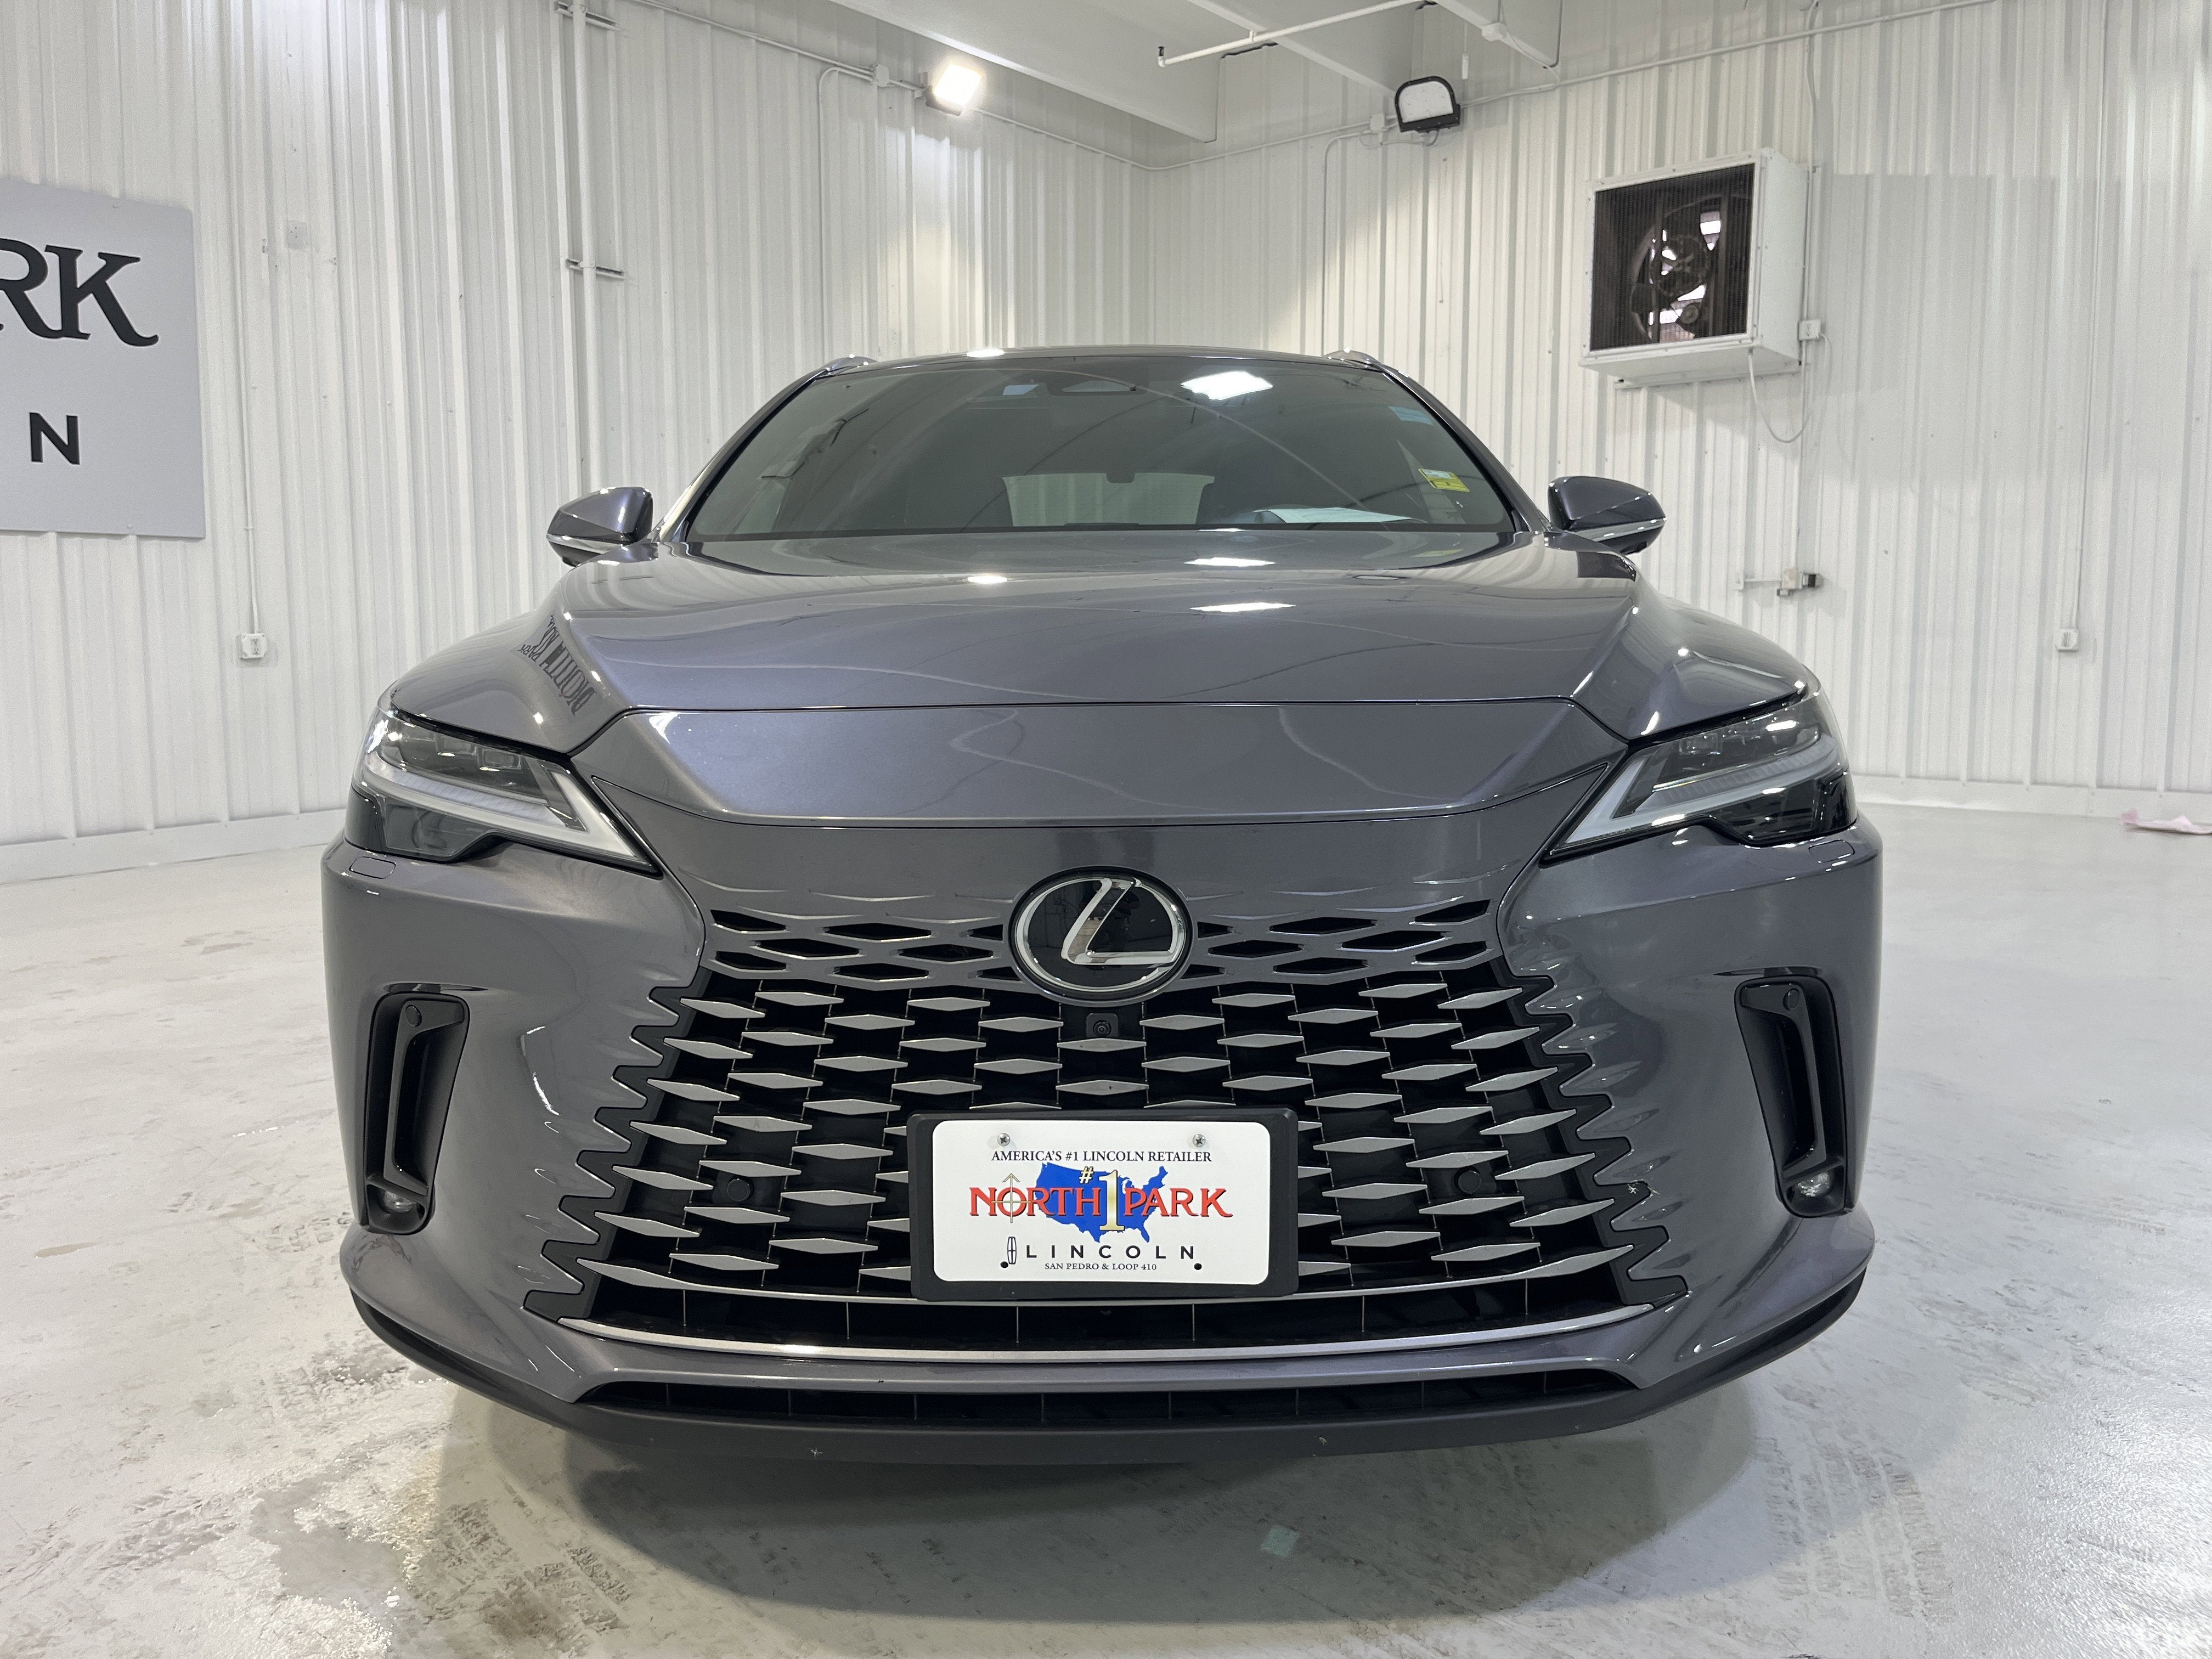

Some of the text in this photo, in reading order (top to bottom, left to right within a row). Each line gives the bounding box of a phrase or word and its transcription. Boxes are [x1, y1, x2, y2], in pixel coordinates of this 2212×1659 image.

[991, 1150, 1212, 1162] AMERICA'S #1 LINCOLN RETAILER
[969, 1187, 1234, 1217] NORTH PARK
[1026, 1244, 1194, 1260] LINCOLN
